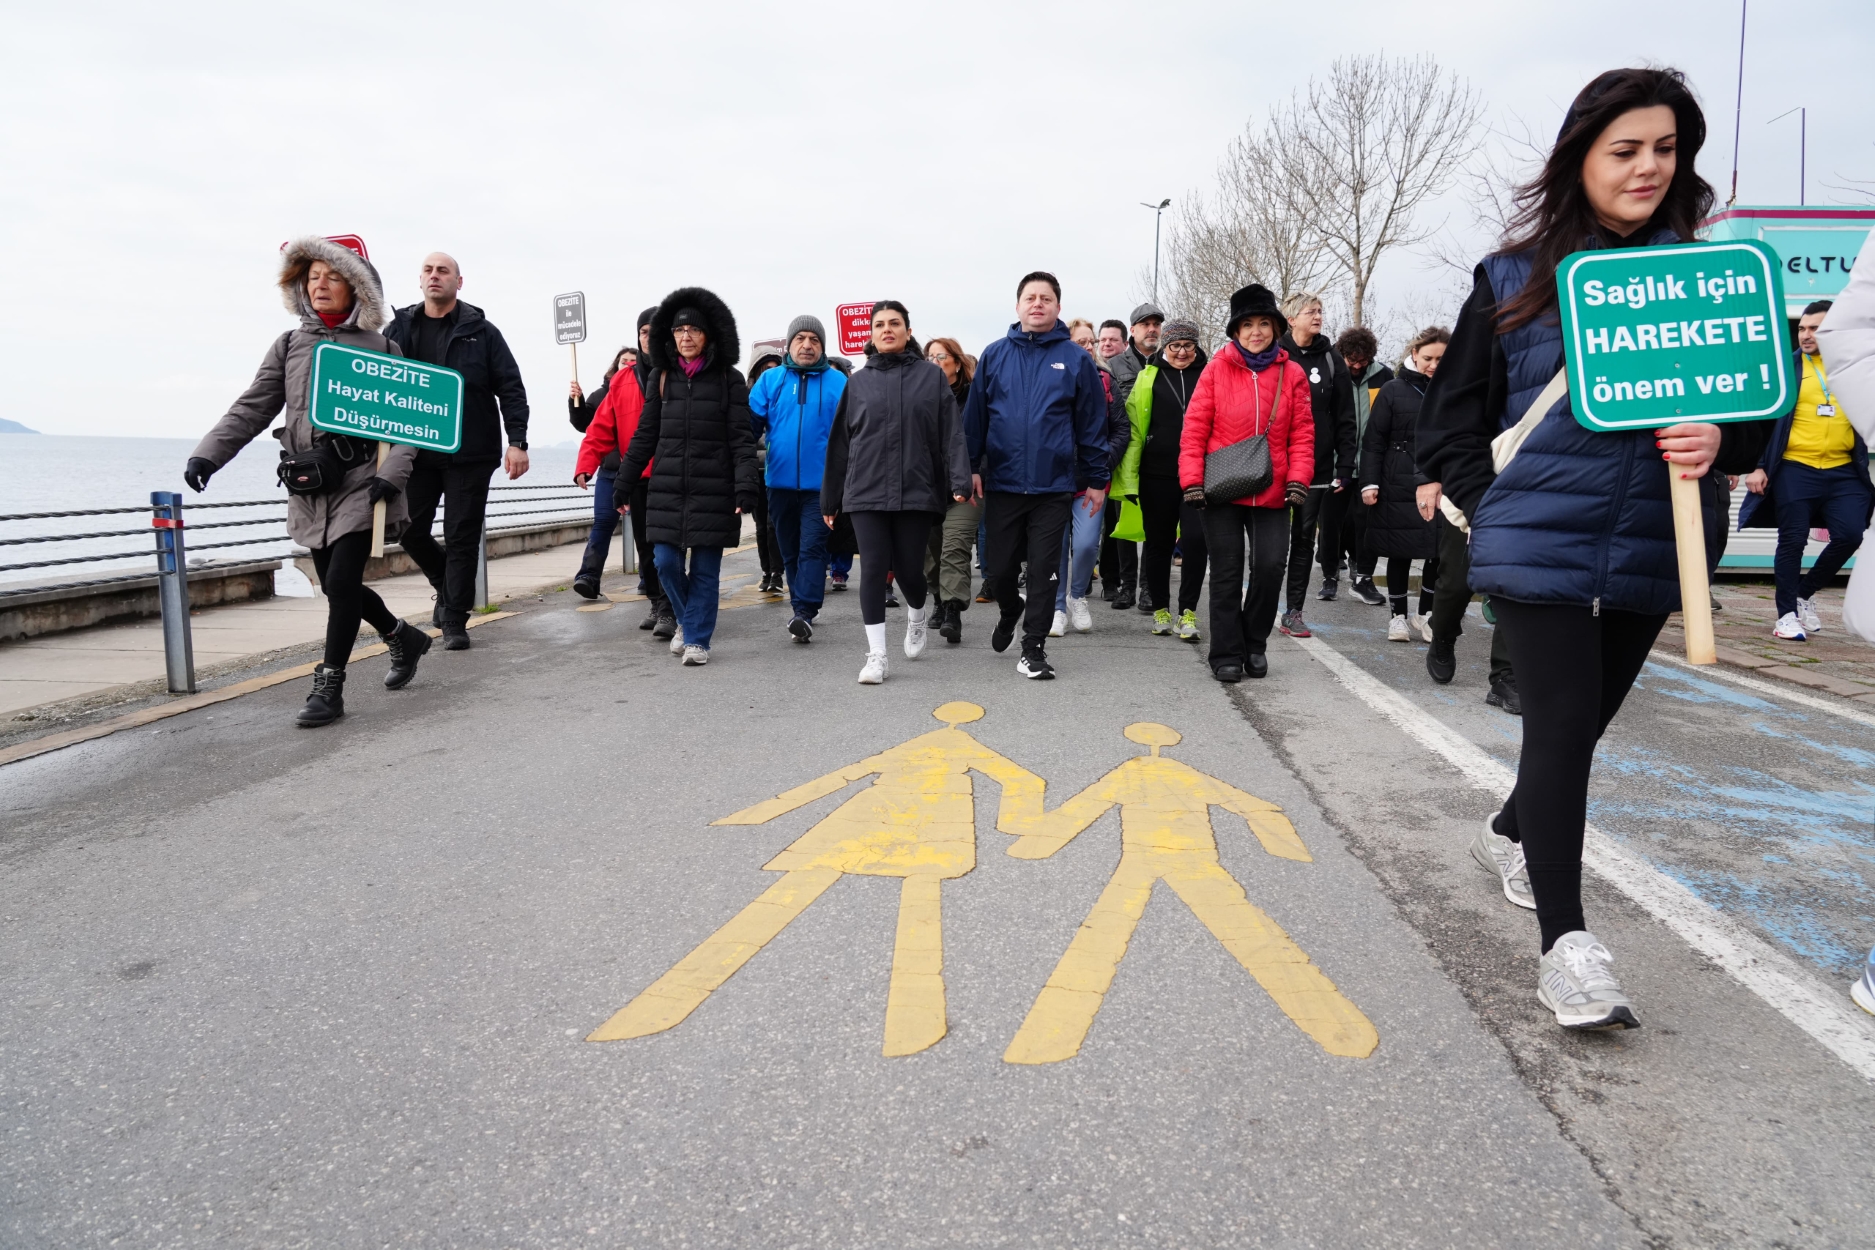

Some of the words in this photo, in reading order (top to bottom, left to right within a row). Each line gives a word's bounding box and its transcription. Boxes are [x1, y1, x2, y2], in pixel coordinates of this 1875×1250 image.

[1780, 256, 1857, 273] ELTU
[558, 296, 579, 307] OBEZİTE
[1584, 274, 1687, 309] Sağlık
[1696, 269, 1757, 304] için
[842, 305, 873, 316] OBEZİT
[845, 340, 866, 348] harek
[1585, 315, 1767, 354] HAREKETE
[351, 358, 431, 388] OBEZİTE
[1593, 375, 1685, 403] önem
[1695, 372, 1748, 394] ver
[327, 379, 379, 404] Hayat
[385, 391, 449, 417] Kaliteni
[334, 407, 439, 440] Düşürmesin
